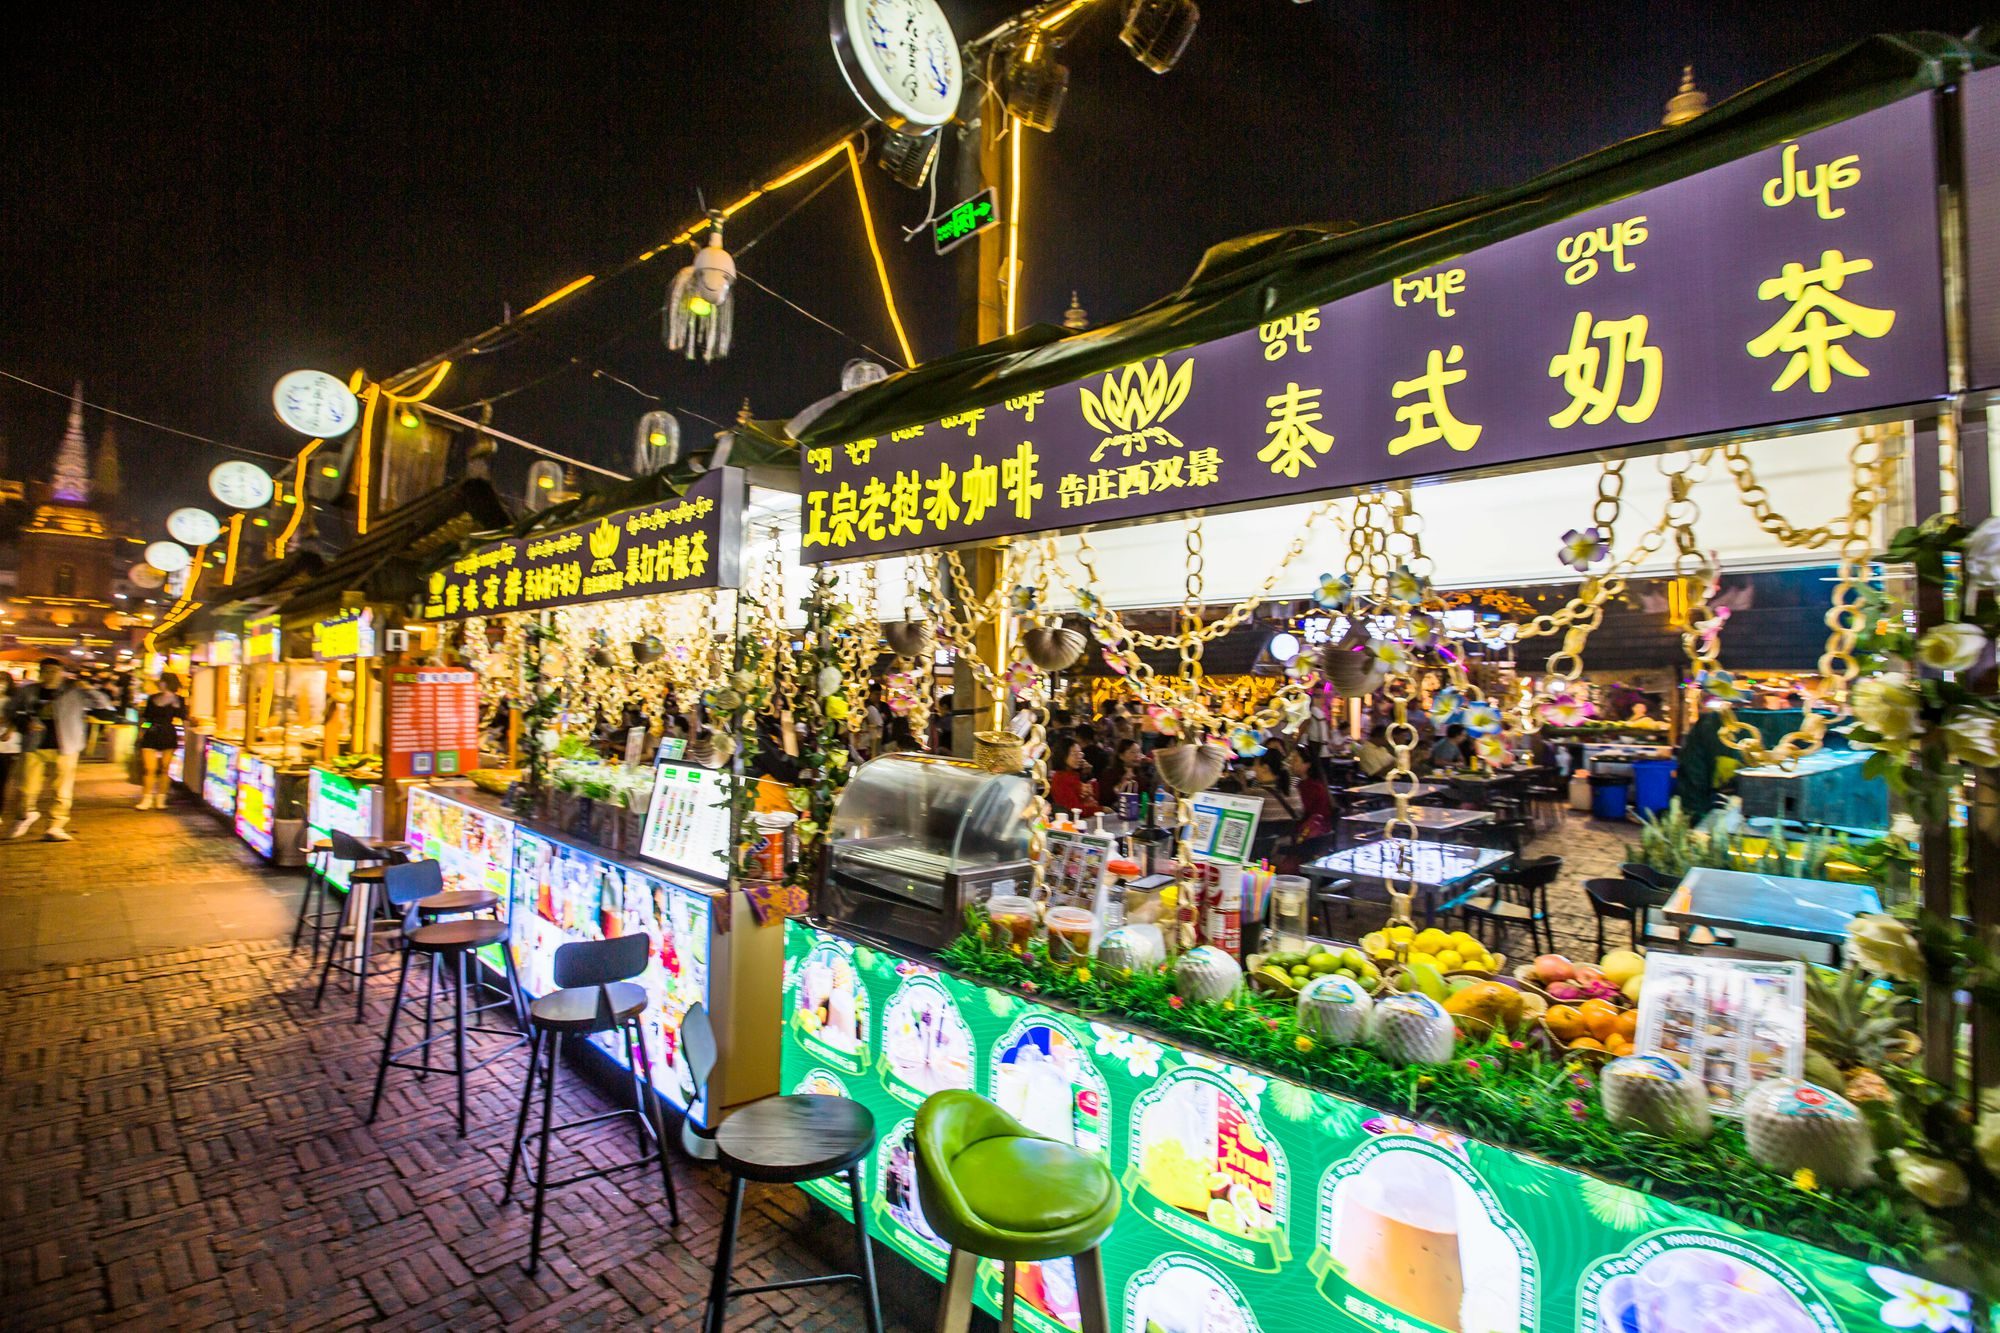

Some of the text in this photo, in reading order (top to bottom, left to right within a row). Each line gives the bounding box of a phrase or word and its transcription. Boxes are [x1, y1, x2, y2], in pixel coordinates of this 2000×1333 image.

[1257, 248, 1896, 478] 泰式奶茶
[802, 440, 1043, 548] 正宗老挝冰咖啡
[1057, 446, 1225, 509] 告庄西双景
